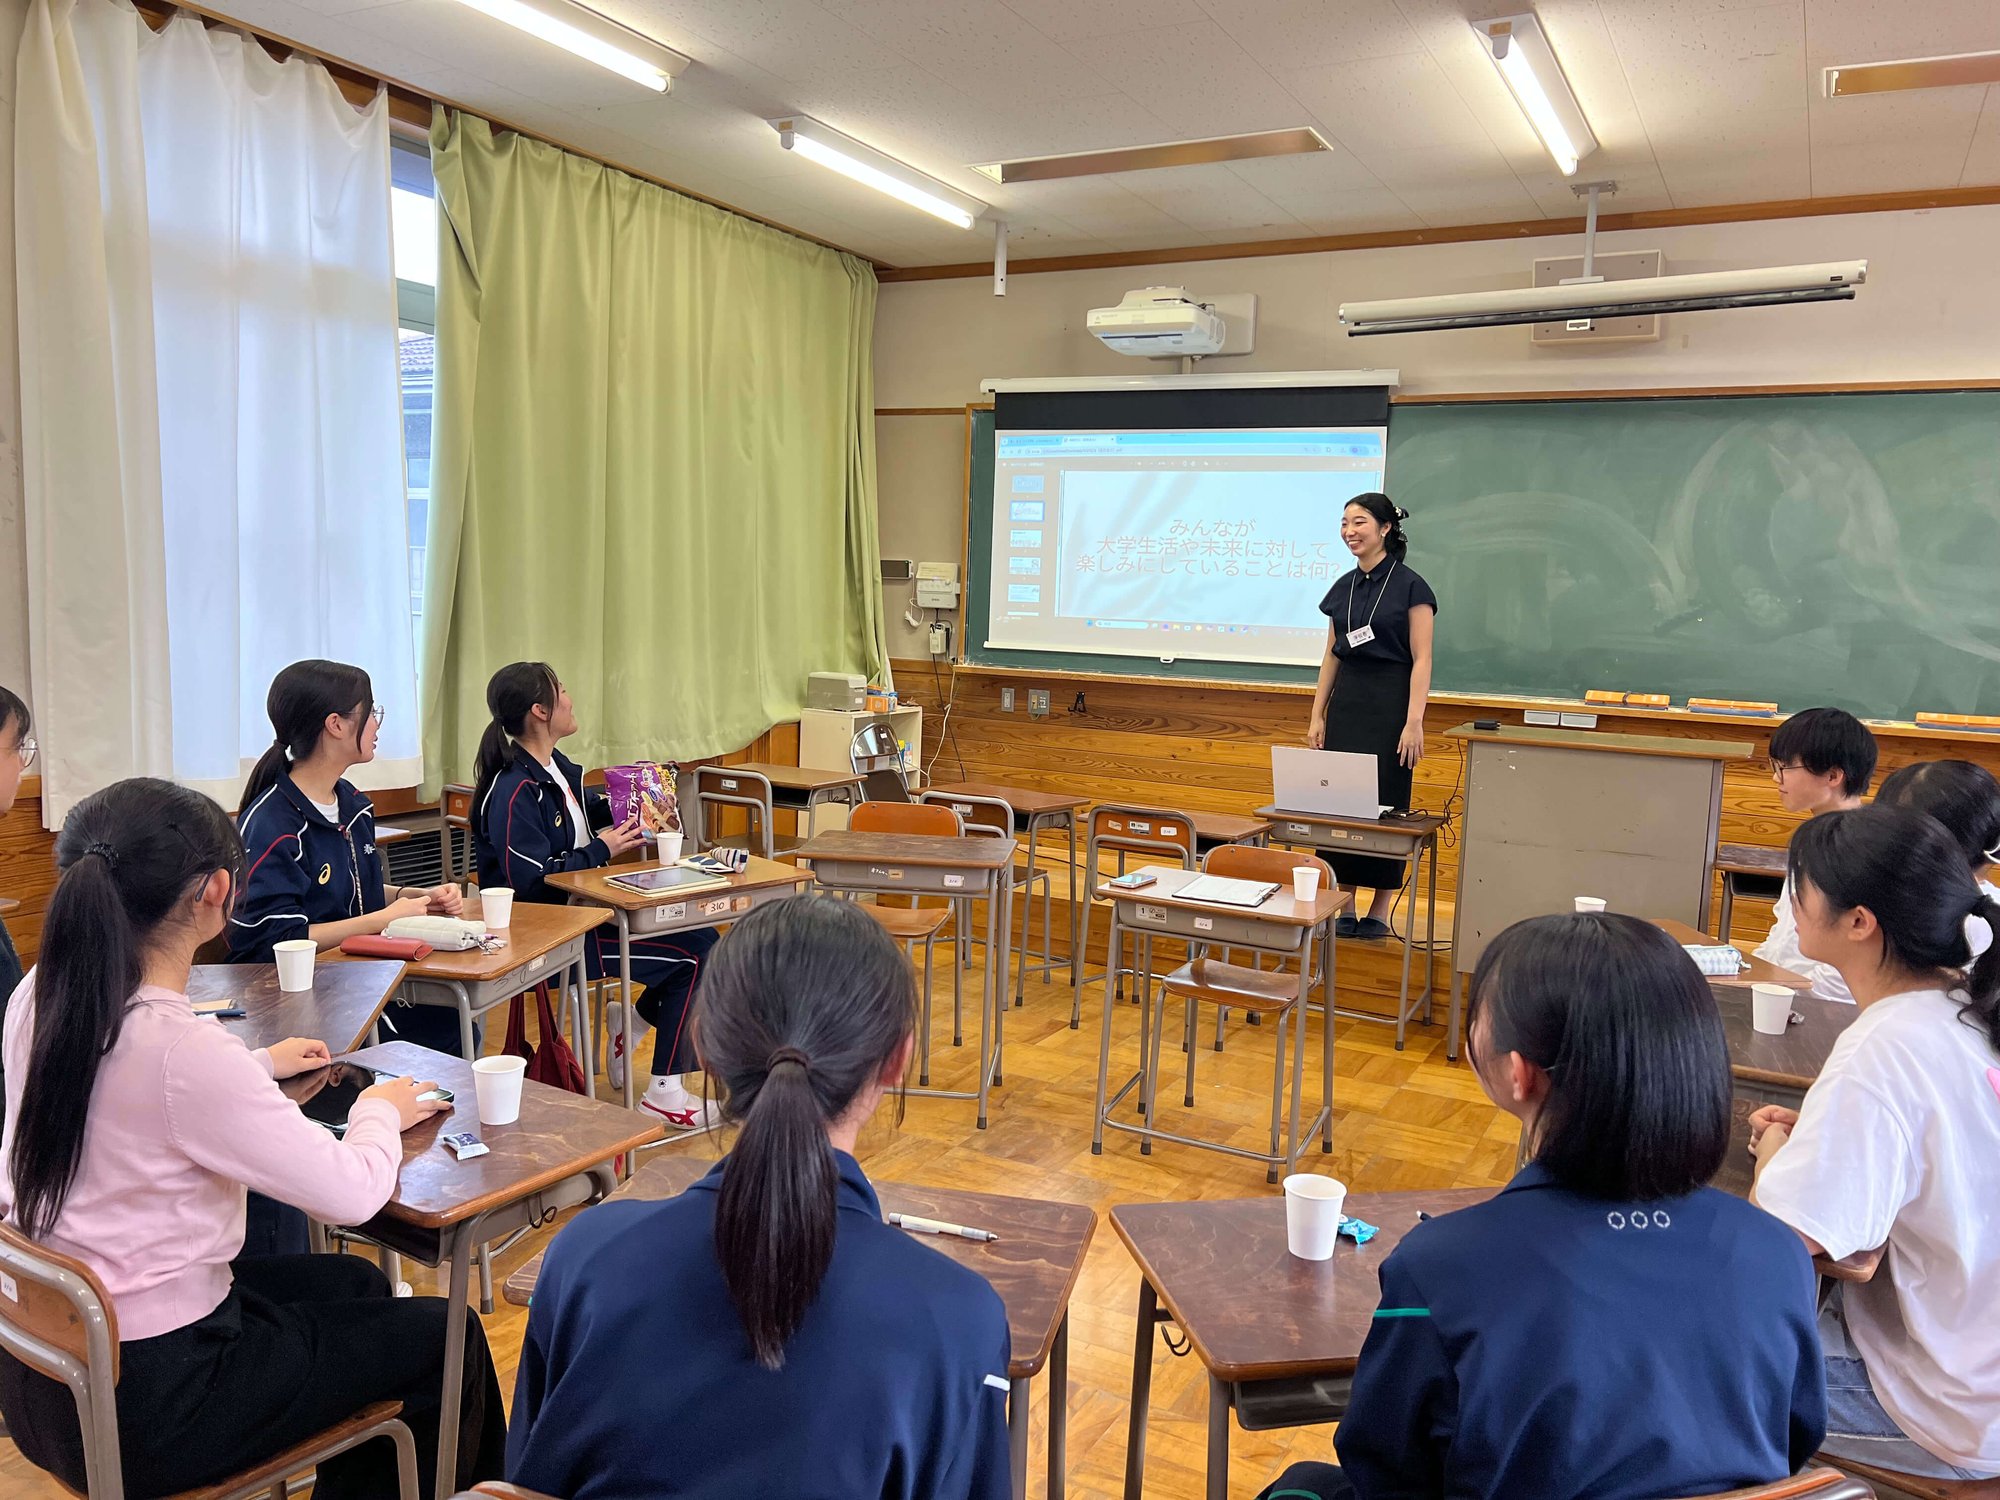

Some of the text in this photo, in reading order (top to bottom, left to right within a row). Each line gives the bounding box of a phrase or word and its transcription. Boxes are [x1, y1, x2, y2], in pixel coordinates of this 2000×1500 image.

[1169, 519, 1257, 537] みんなが
[1096, 535, 1330, 559] 大学生活や未来に対して
[1075, 555, 1341, 580] 楽しみにしていることは何?
[710, 902, 725, 912] 310
